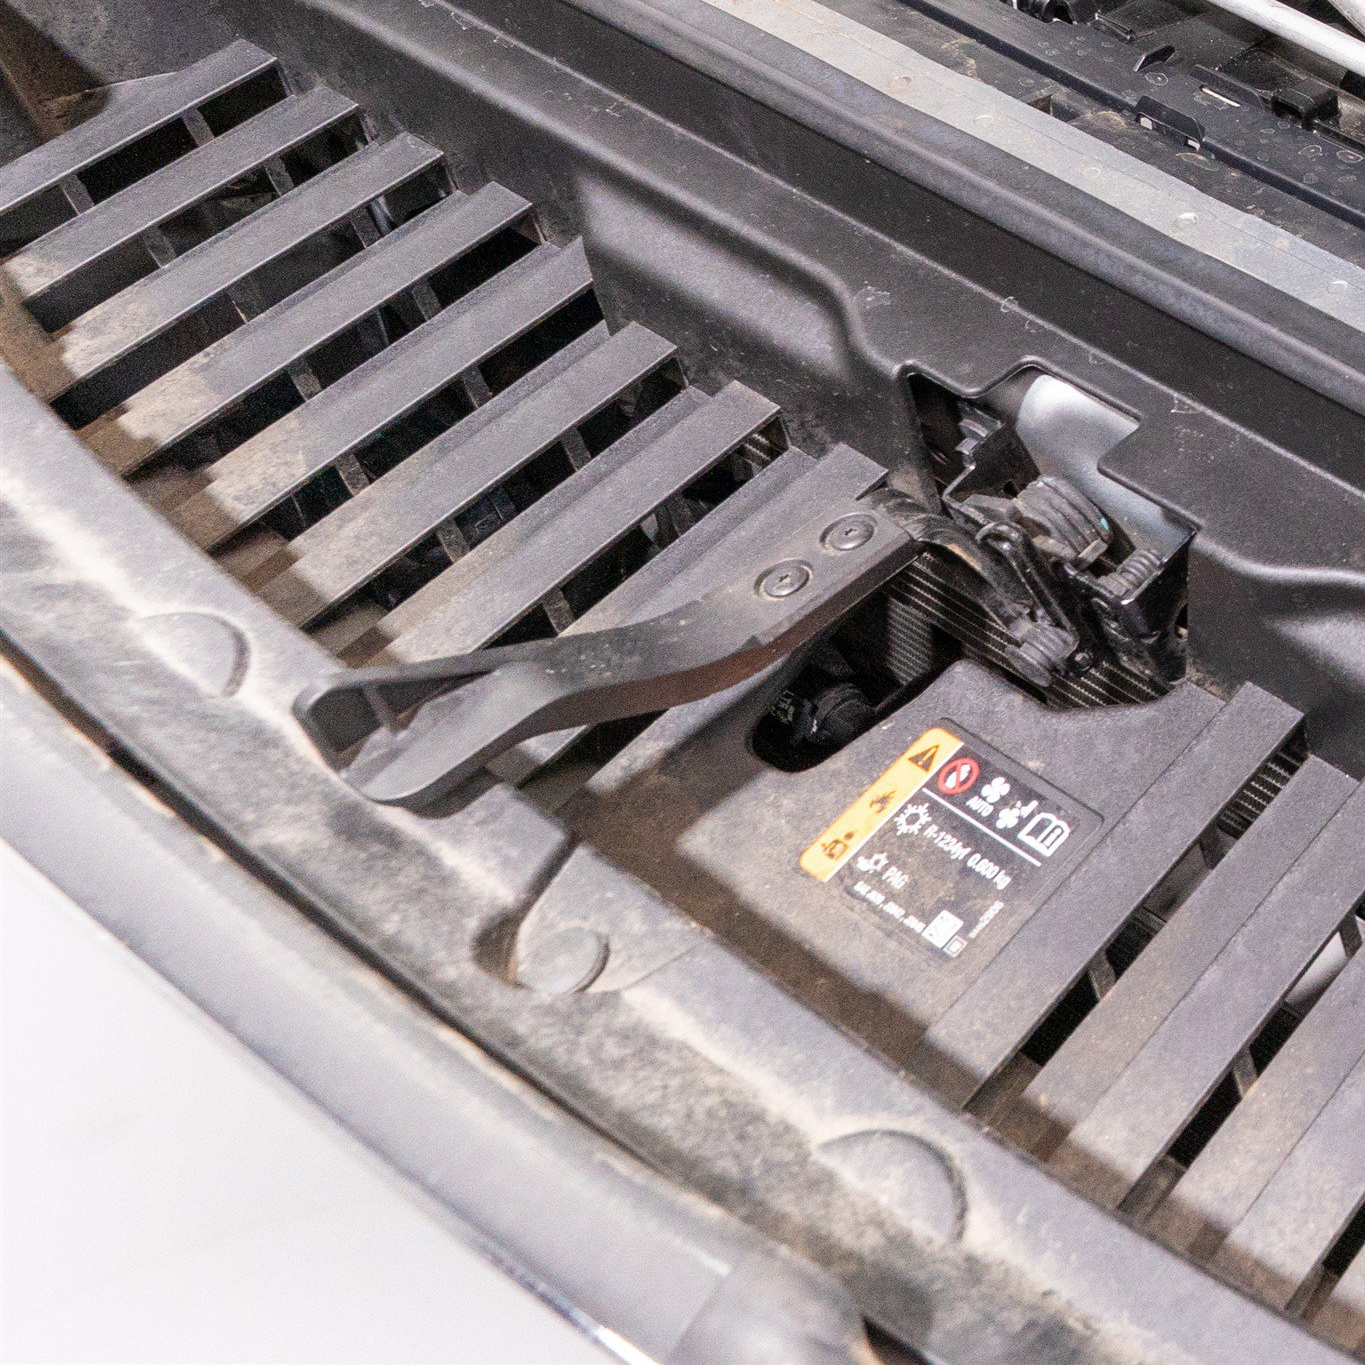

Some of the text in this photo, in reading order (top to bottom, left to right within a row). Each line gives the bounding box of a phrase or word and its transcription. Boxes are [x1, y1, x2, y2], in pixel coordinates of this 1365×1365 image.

[965, 795, 994, 817] AUTO
[881, 866, 909, 889] PAG
[967, 853, 999, 879] 0.600
[993, 869, 1012, 890] kg
